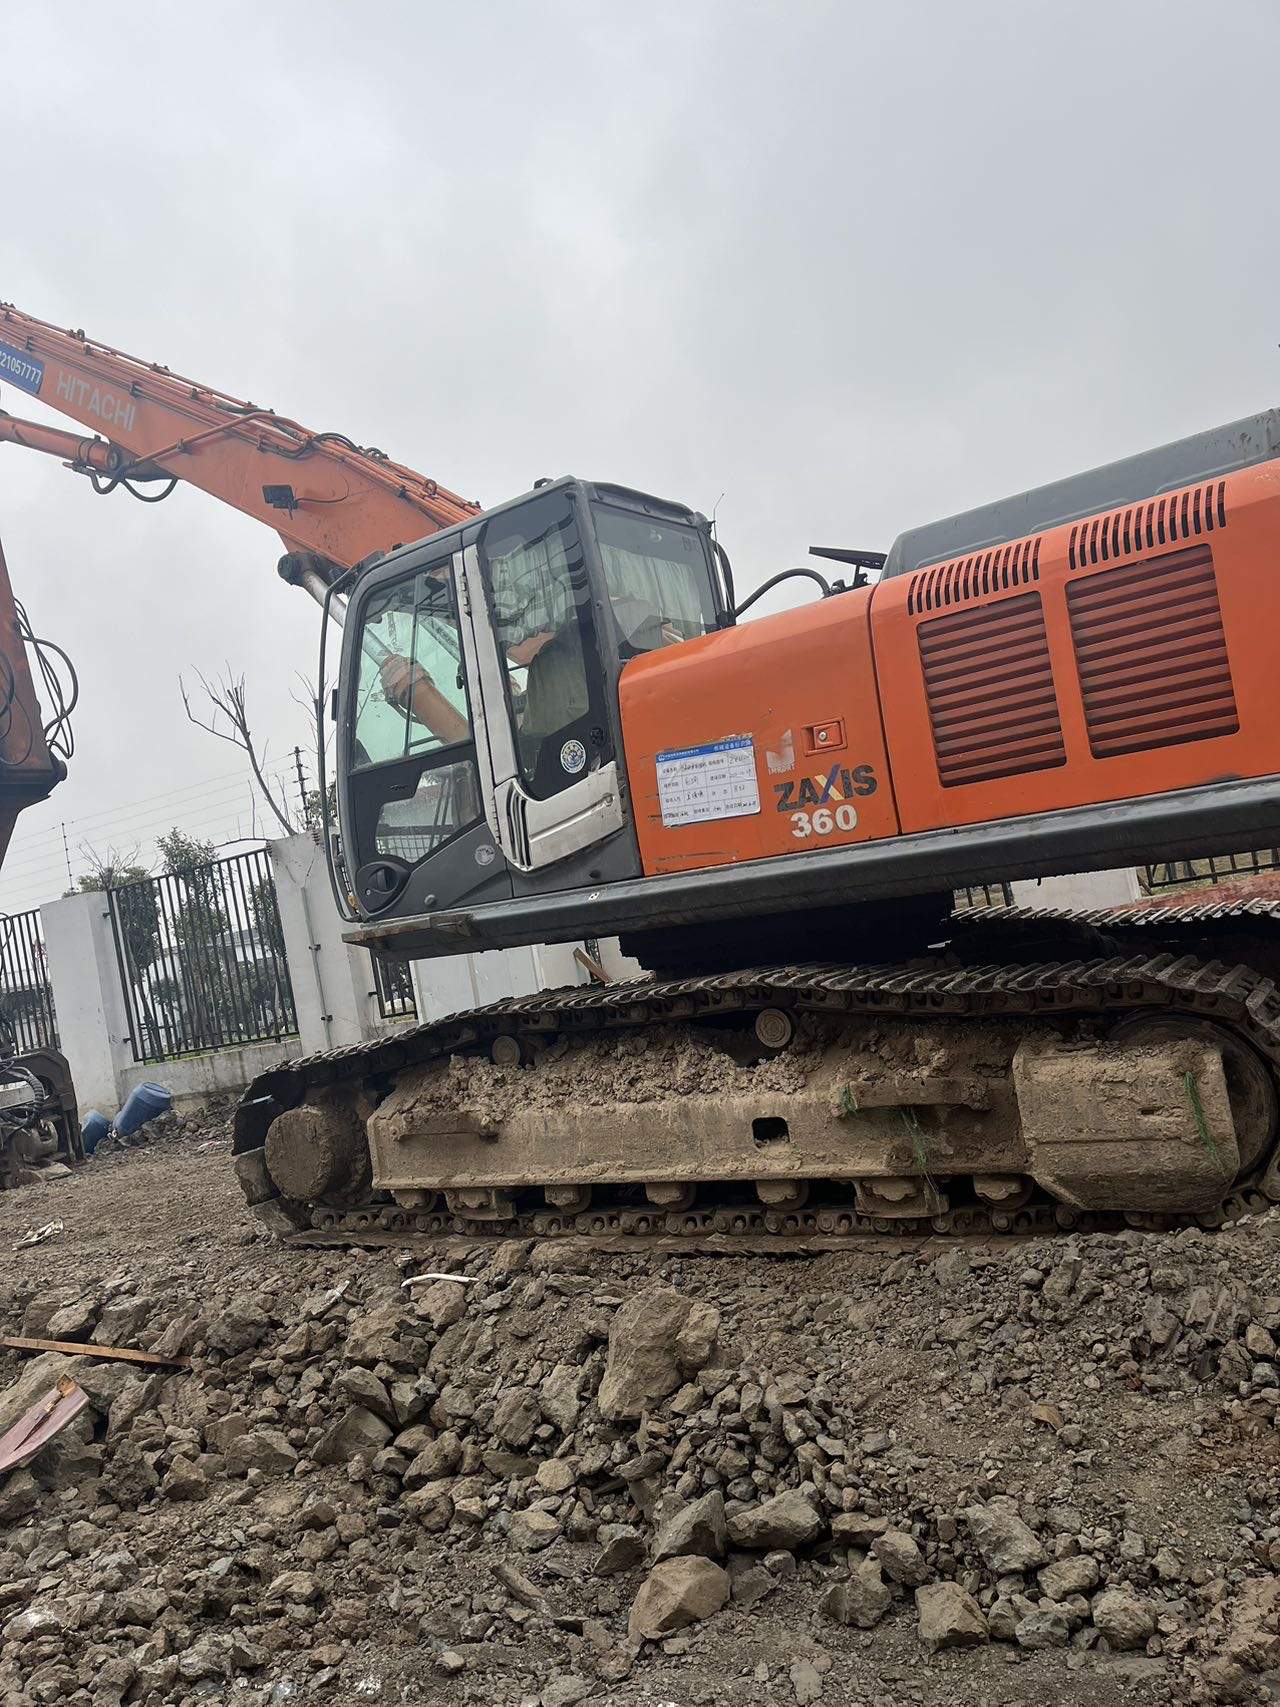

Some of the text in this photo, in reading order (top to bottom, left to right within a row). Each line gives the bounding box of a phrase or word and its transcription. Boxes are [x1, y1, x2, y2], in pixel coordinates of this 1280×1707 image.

[57, 371, 136, 432] HITACHI
[774, 763, 878, 813] ZAXIS
[791, 804, 858, 838] 360
